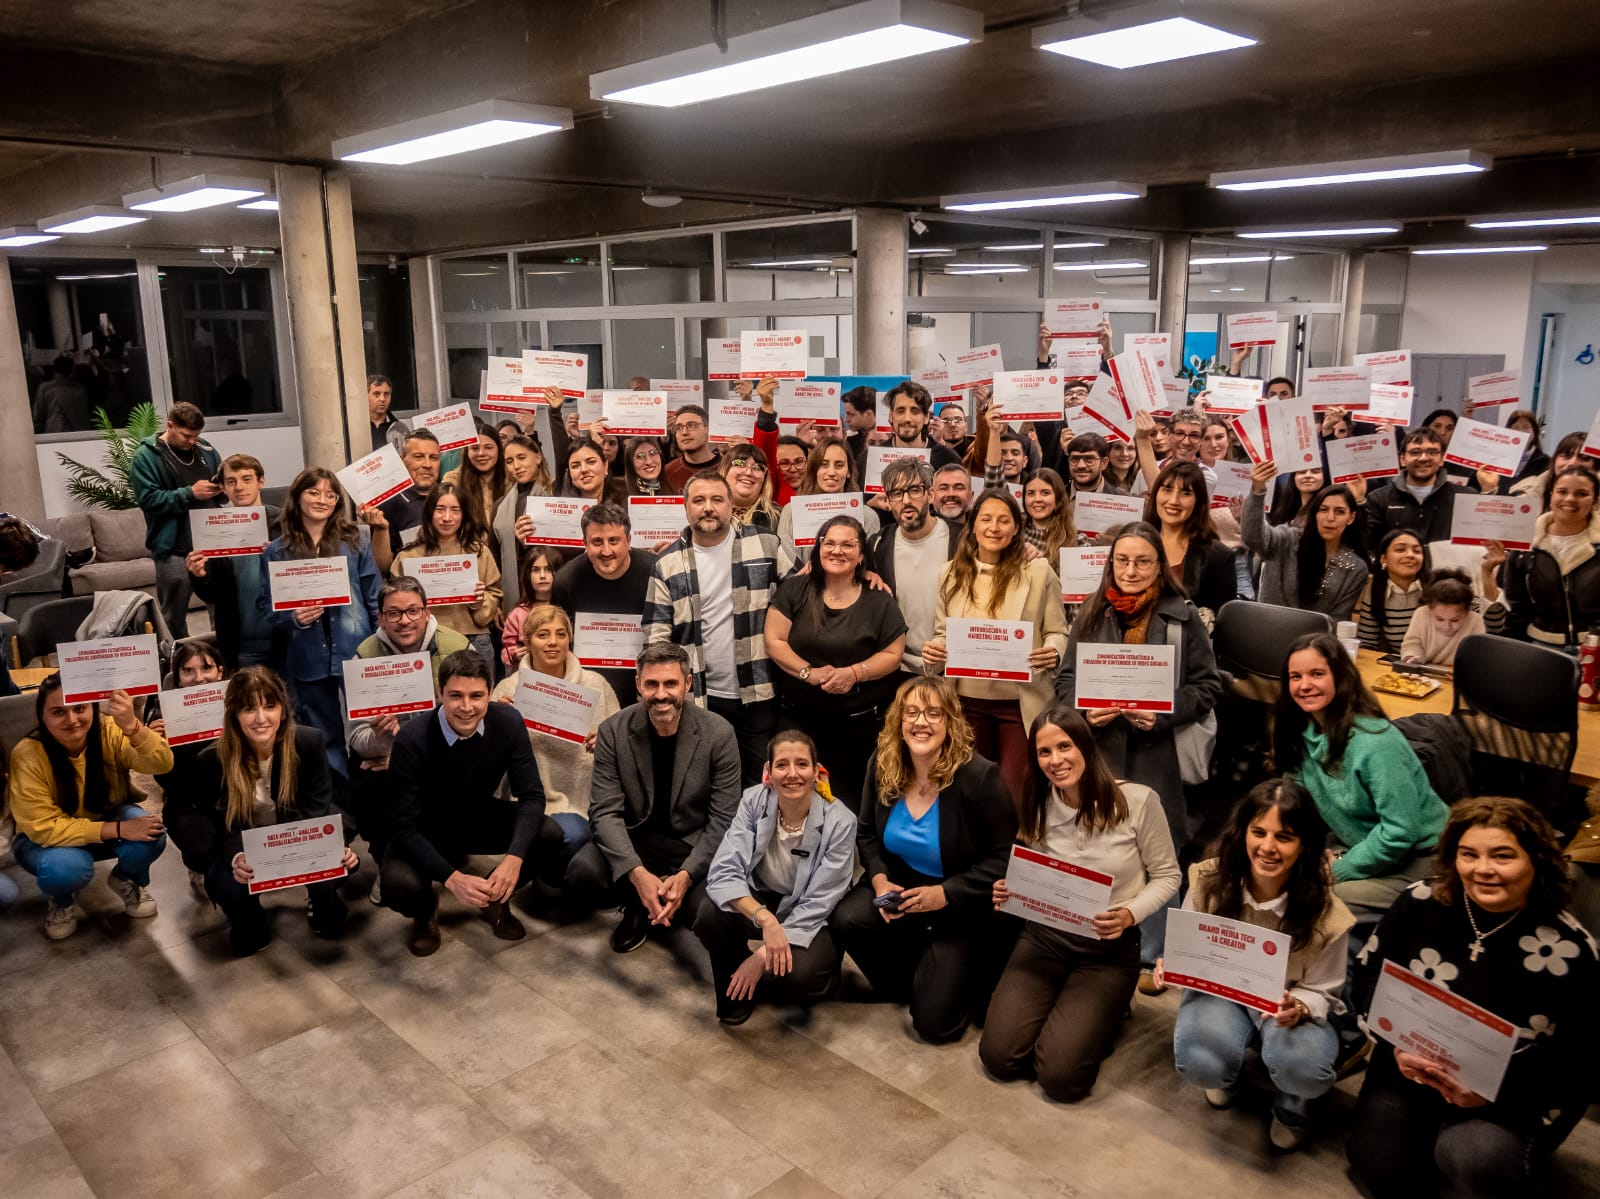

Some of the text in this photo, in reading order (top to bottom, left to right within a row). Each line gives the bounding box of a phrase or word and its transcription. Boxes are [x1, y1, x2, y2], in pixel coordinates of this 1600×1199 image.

[1198, 923, 1219, 934] BRAND
[1220, 928, 1239, 939] MEDIA
[1240, 933, 1256, 944] TECH
[1219, 937, 1246, 950] CREATOR
